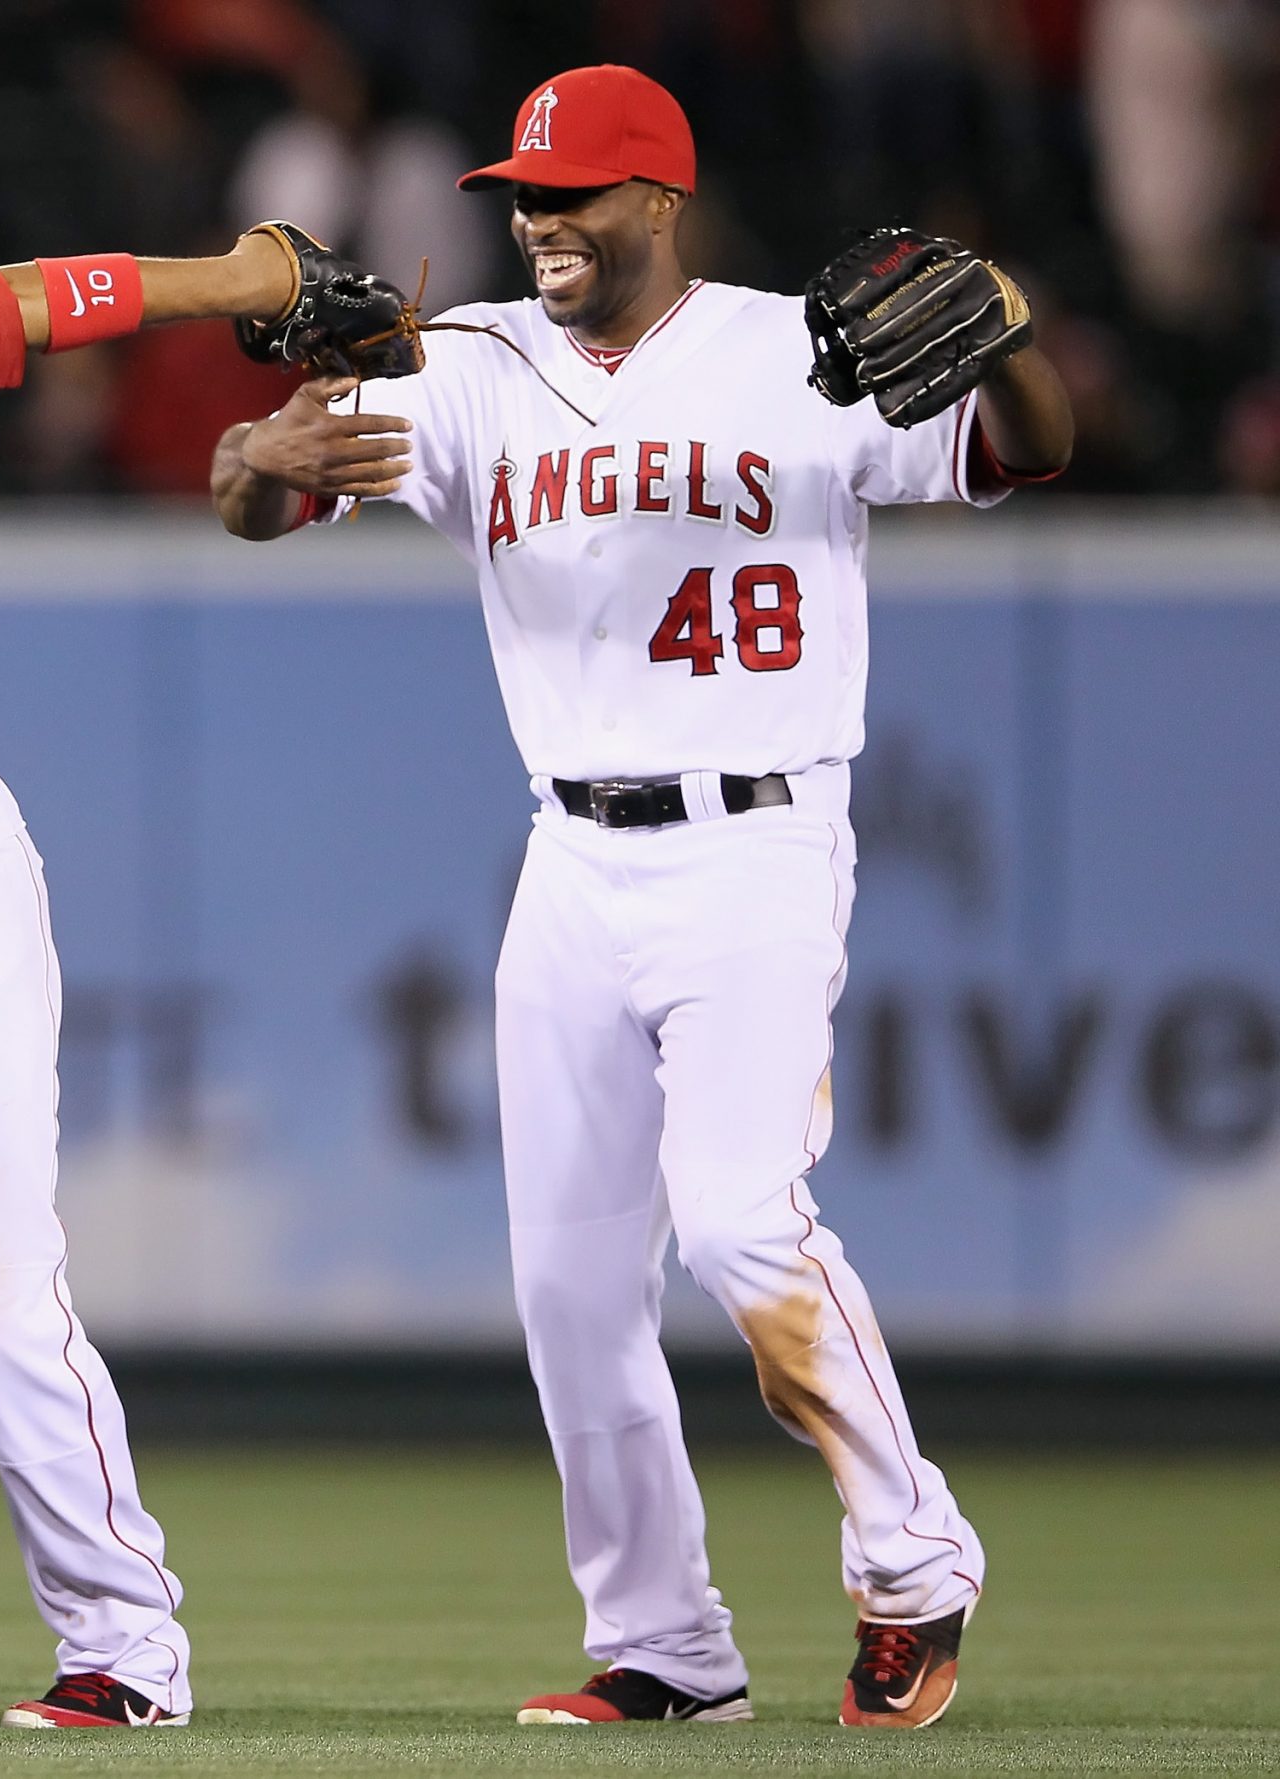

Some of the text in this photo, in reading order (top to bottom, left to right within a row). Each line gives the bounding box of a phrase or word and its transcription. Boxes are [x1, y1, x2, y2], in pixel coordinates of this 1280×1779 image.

[518, 86, 558, 151] A
[88, 269, 115, 306] 10
[488, 439, 776, 562] ANGELS
[648, 562, 806, 678] 48
